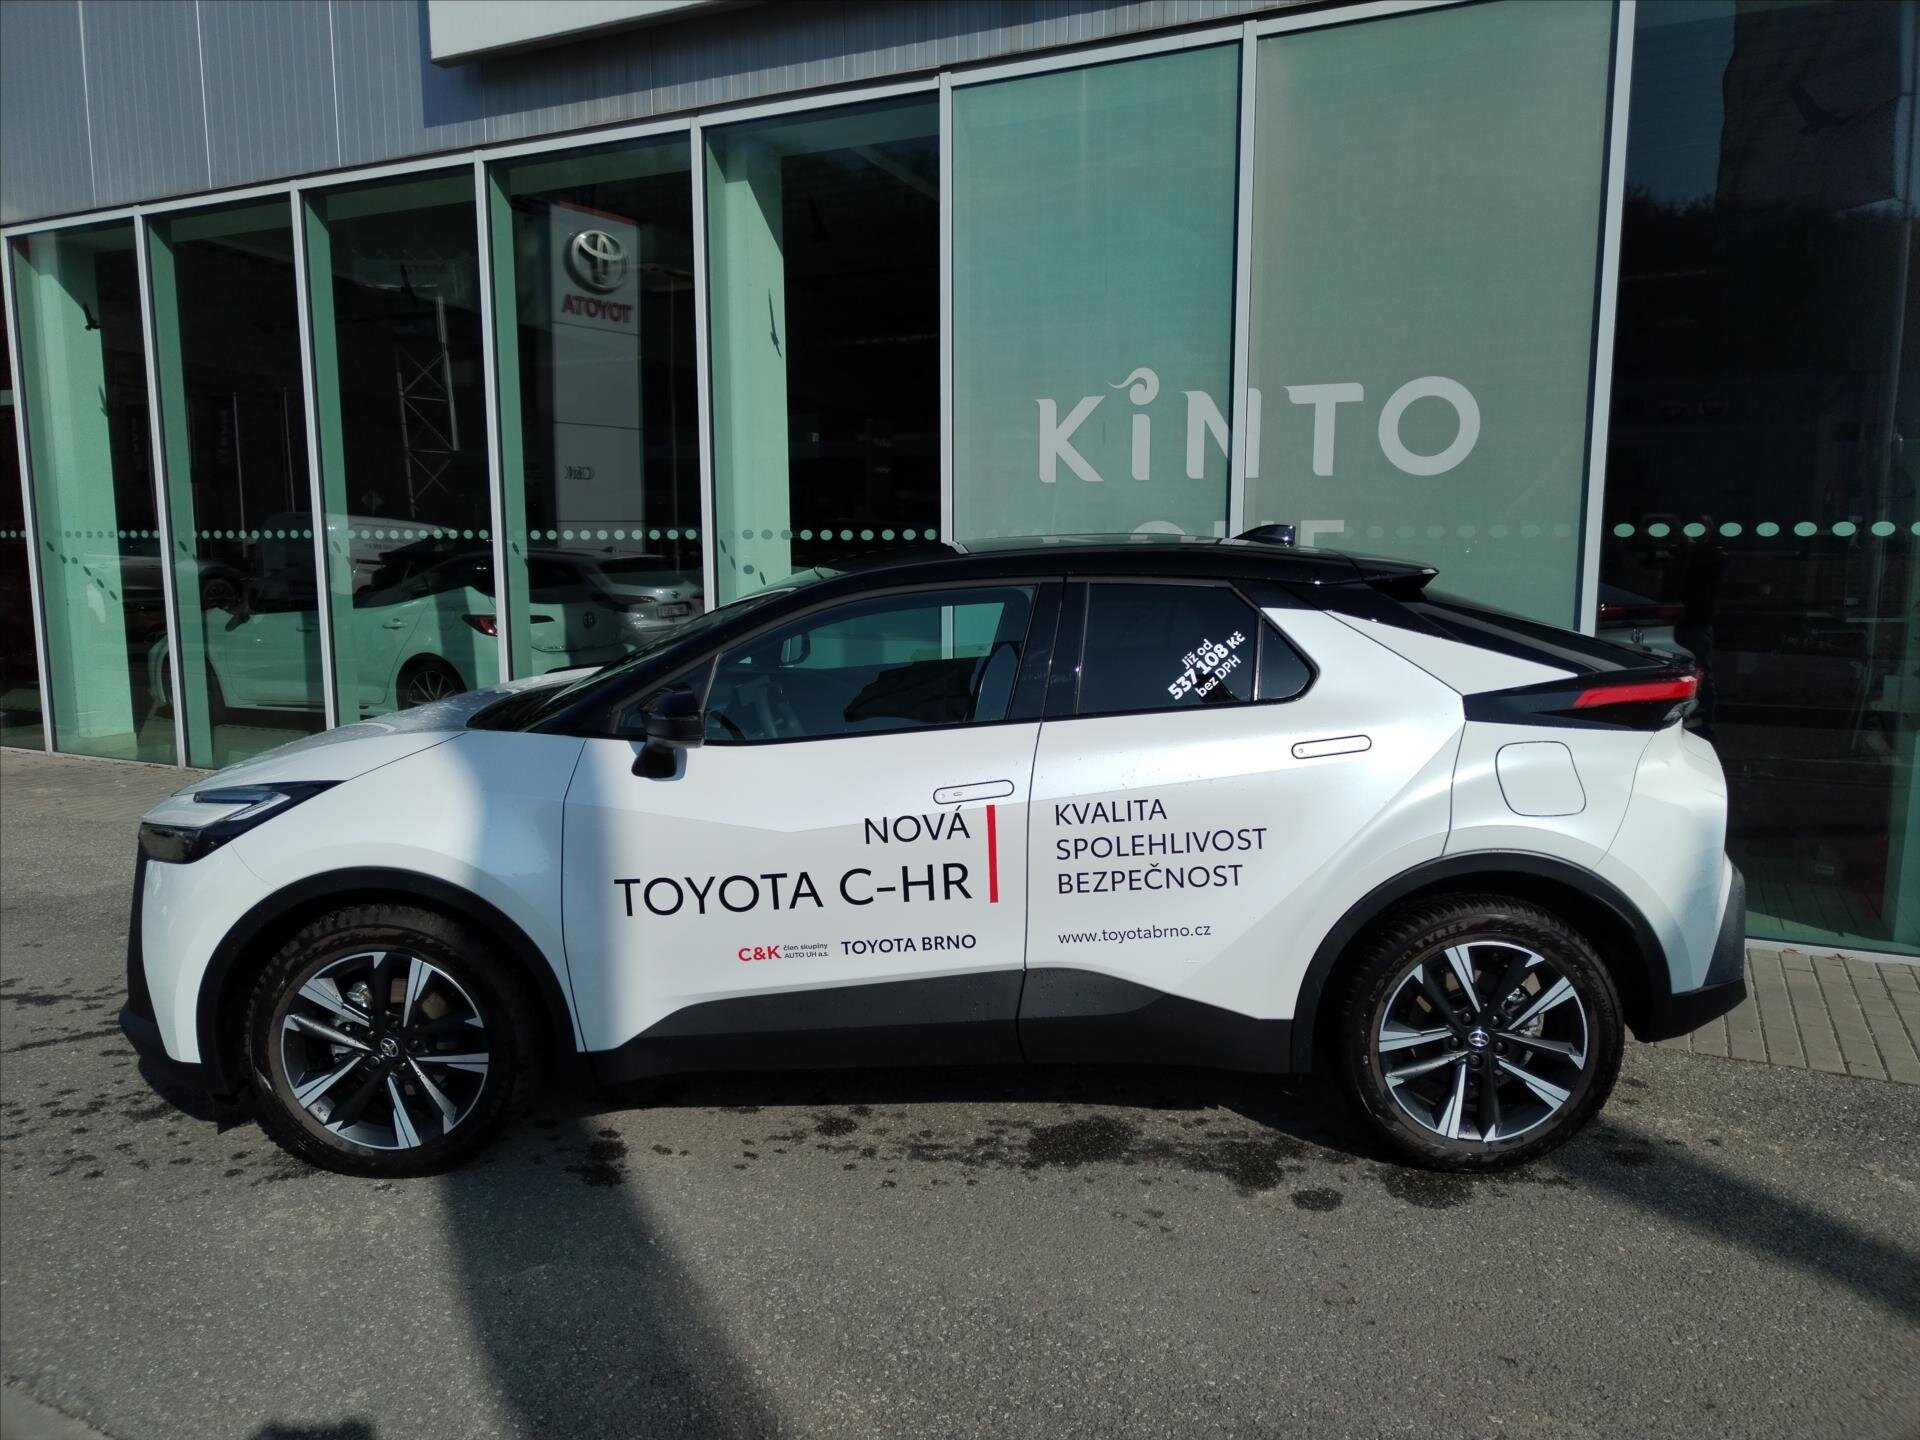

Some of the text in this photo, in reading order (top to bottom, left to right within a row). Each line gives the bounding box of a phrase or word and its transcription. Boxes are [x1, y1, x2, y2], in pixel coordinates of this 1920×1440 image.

[1167, 630, 1246, 700] 537 108 Kč
[1182, 638, 1213, 670] Již od
[1194, 654, 1241, 697] bez DPH
[864, 804, 971, 845] NOVÁ
[1055, 798, 1168, 827] KVALITA
[1056, 827, 1268, 861] SPOLEHLIVOST
[613, 862, 974, 917] TOYOTA C-HR
[1057, 862, 1244, 896] BEZPEČNOST
[841, 933, 978, 956] TOYOTA BRNO
[1057, 925, 1212, 944] www.toyotabrno.cz
[738, 945, 782, 962] C&K
